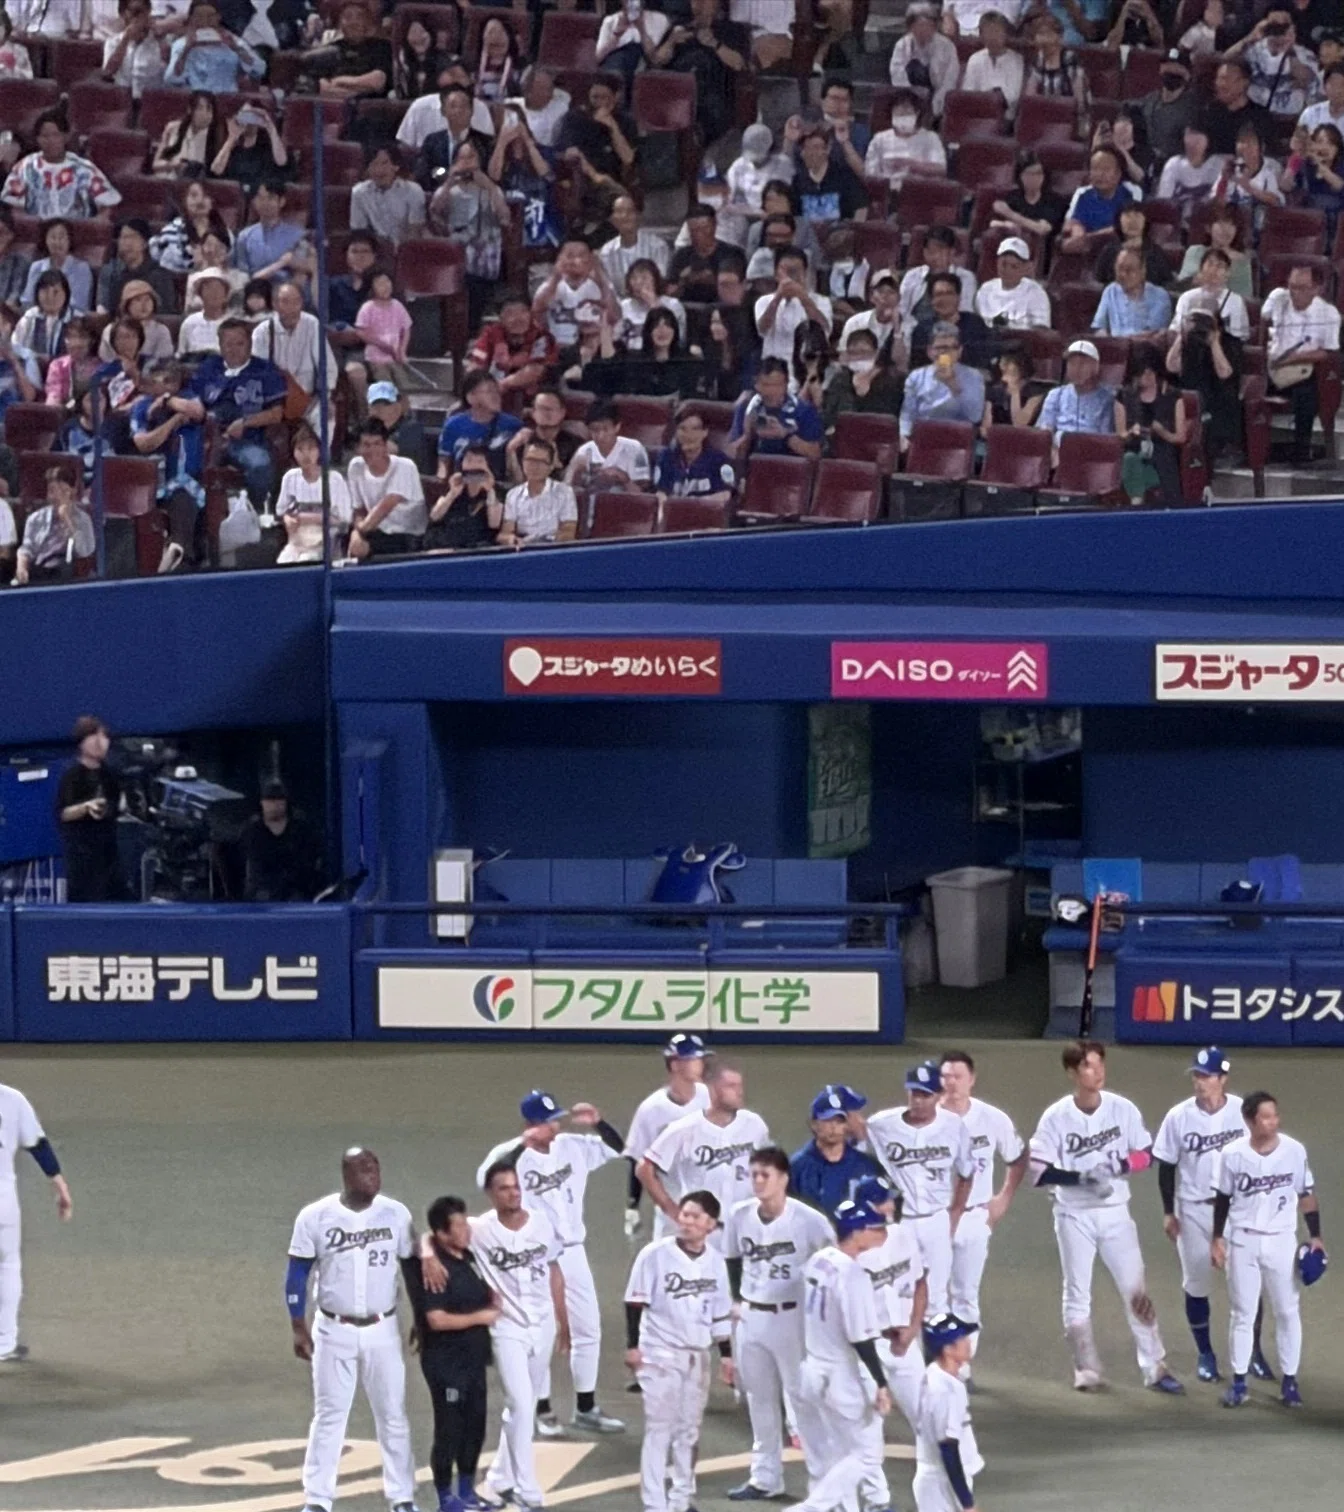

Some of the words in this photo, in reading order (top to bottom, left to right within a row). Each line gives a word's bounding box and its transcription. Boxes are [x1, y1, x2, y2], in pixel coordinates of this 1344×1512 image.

[543, 655, 717, 677] スジャータめいらく
[841, 660, 954, 682] DAISO
[1162, 654, 1320, 690] スジャータ
[47, 955, 318, 1001] 東海テレビ
[533, 976, 811, 1024] フタムラ化学
[325, 1226, 393, 1254] Dragons
[368, 1250, 389, 1267] 23
[769, 1263, 791, 1280] 25
